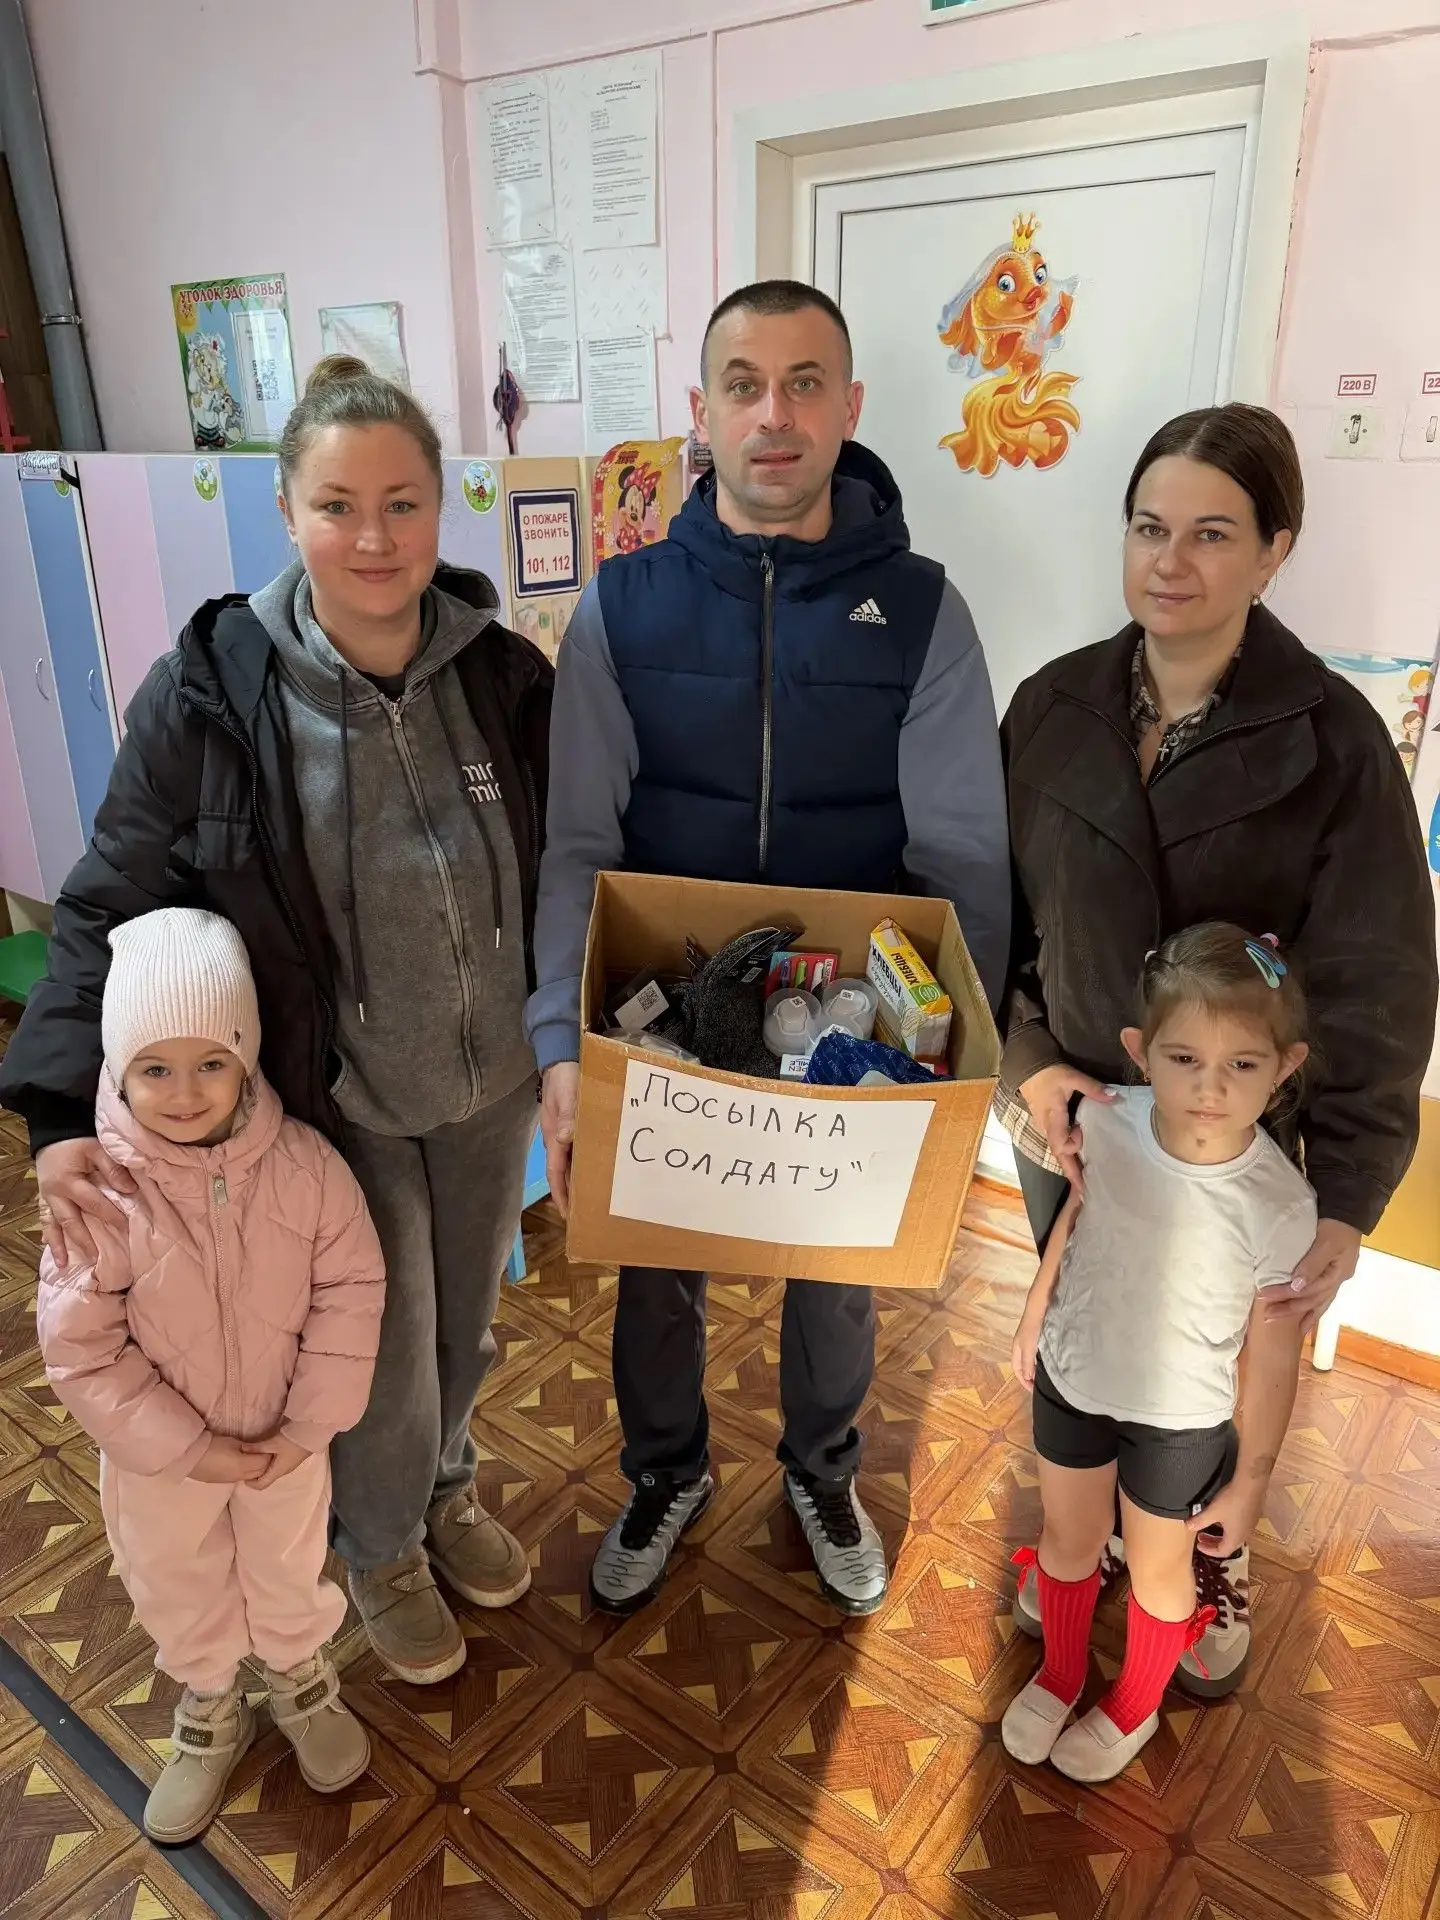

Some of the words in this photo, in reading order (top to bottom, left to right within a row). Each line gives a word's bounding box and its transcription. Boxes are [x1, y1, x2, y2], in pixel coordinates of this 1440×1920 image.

[179, 287, 221, 304] УГОЛОК
[224, 281, 283, 299] ЗДОРОВЬЯ
[1342, 380, 1361, 391] 220
[523, 515, 530, 525] О
[532, 513, 568, 525] ПОЖАРЕ
[524, 527, 569, 540] ЗВОНИТЬ
[526, 557, 549, 575] 101,
[552, 555, 570, 572] 112
[849, 612, 887, 625] adidas
[890, 952, 921, 986] ХЛЕБЦЫ
[302, 1687, 325, 1705] CLASSIC
[184, 1731, 206, 1744] CLASSIC
